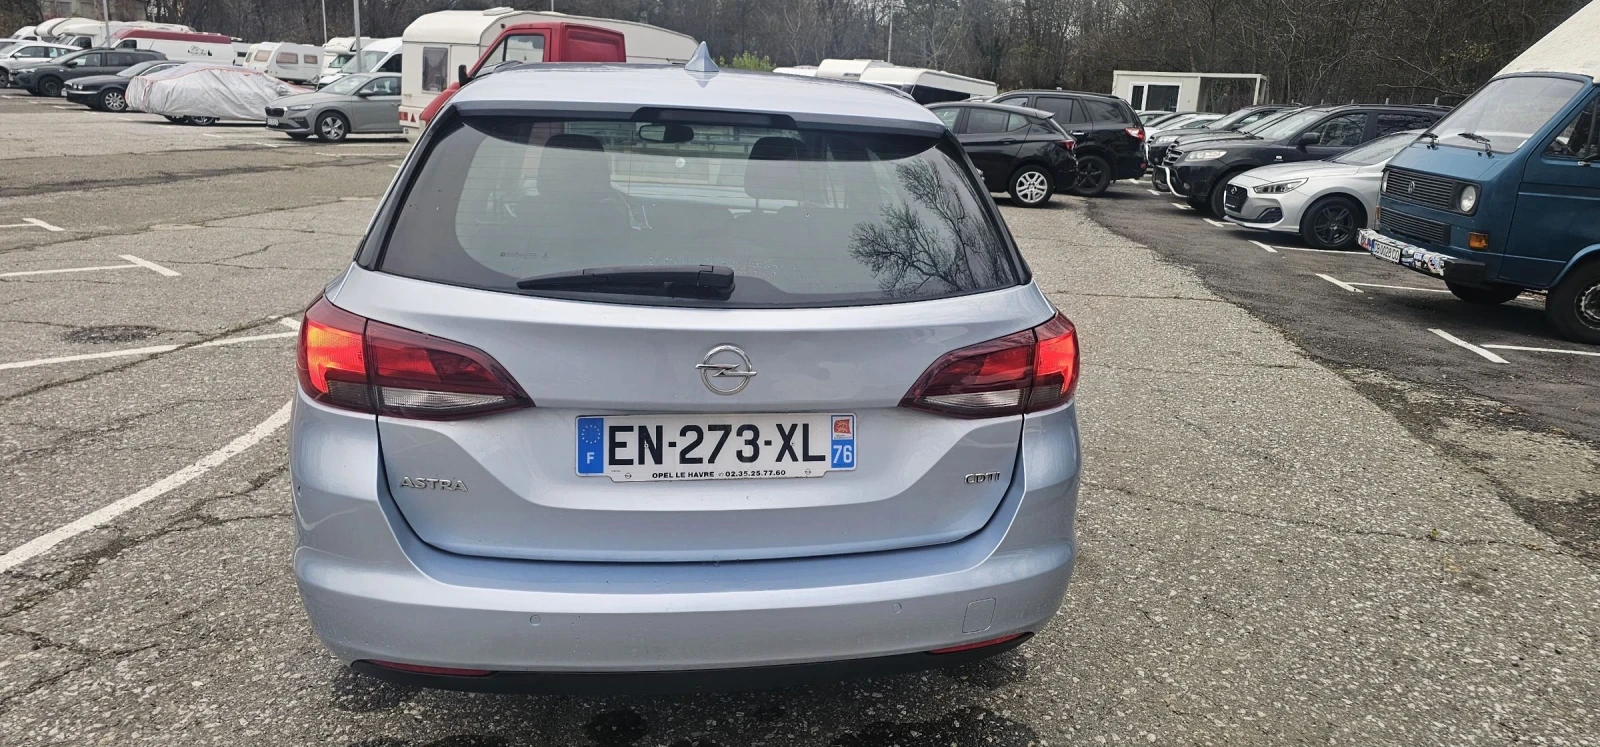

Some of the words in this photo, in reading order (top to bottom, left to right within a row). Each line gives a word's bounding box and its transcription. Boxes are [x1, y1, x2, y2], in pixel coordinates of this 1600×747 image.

[608, 423, 826, 466] EN-273-XL
[586, 451, 595, 464] F
[833, 444, 853, 464] 76
[400, 476, 469, 492] ASTRA
